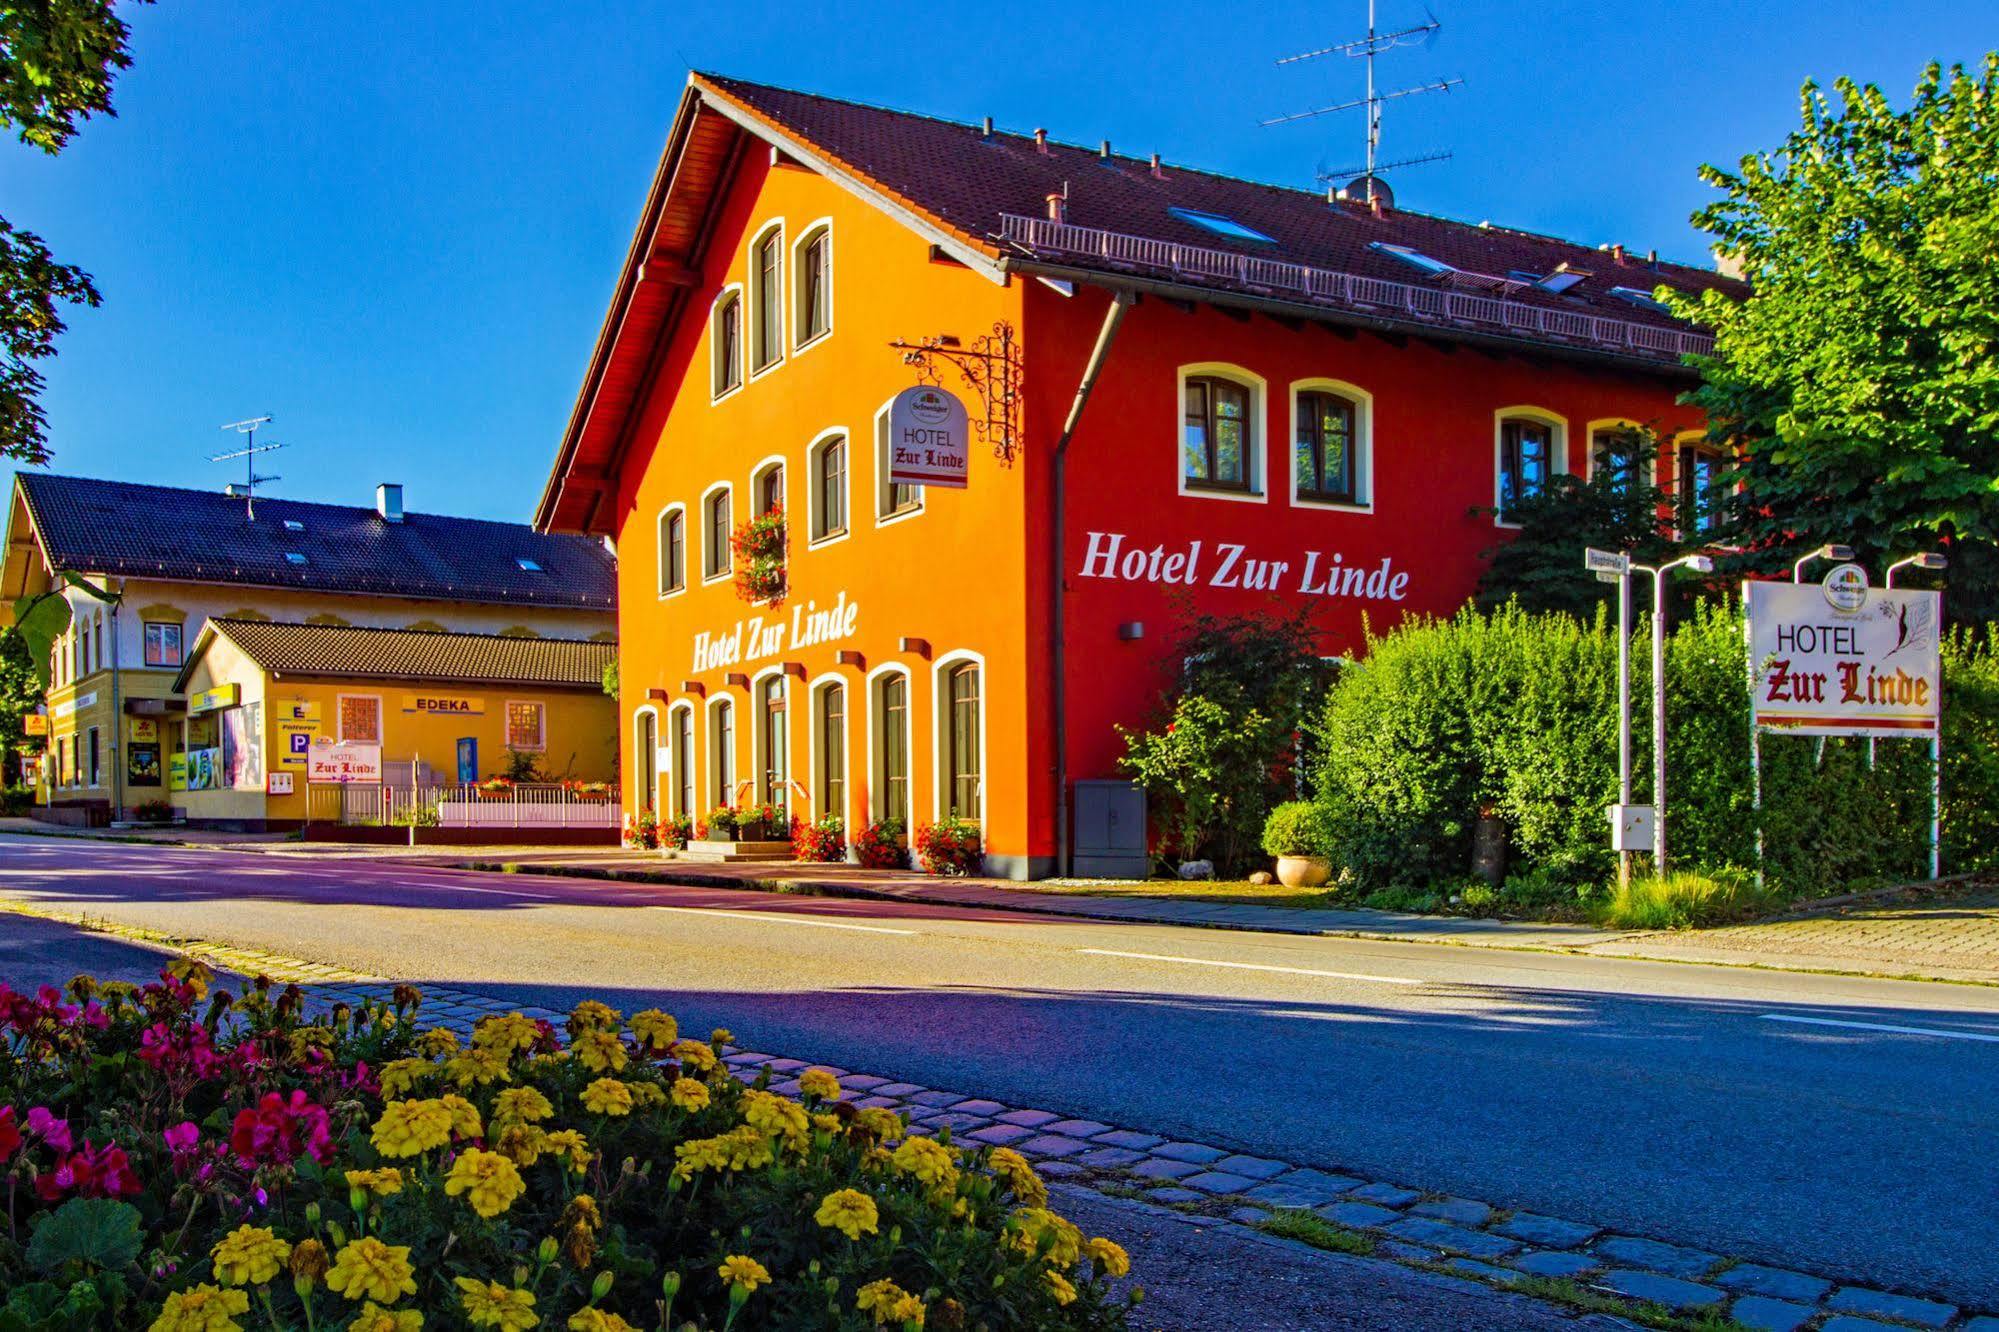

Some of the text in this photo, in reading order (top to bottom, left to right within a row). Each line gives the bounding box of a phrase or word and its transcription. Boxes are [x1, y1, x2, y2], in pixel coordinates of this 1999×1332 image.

[904, 427, 955, 447] HOTEL
[895, 447, 964, 468] Zur Linde
[1078, 531, 1409, 601] Hotel Zur Linde
[692, 591, 858, 674] Hotel Zur Linde
[1777, 624, 1864, 656] HOTEL
[1766, 658, 1930, 707] Zur Linde
[416, 699, 470, 711] EDEKA
[294, 735, 306, 752] P
[331, 753, 359, 761] HOTEL
[315, 761, 377, 774] Zur Linde
